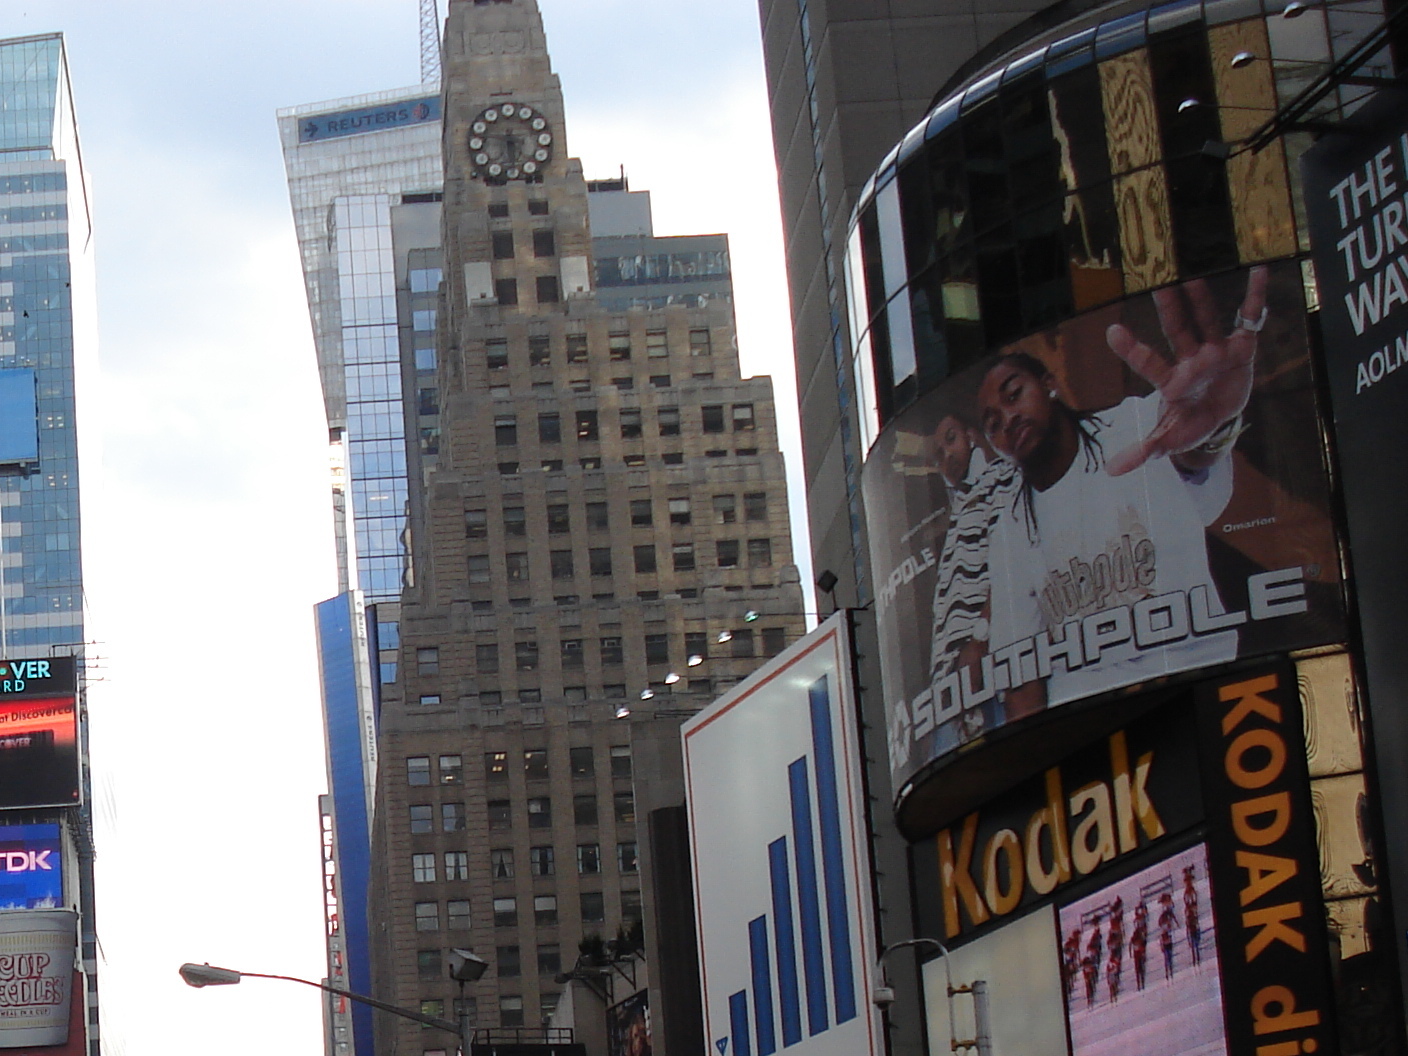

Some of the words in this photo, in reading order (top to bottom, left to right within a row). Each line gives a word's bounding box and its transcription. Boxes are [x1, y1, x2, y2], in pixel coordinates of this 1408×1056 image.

[327, 108, 409, 133] REUTERS
[1329, 146, 1397, 230] THE
[1222, 515, 1277, 534] Omarion
[912, 566, 1308, 742] SOUTHPOLE
[937, 729, 1167, 939] Kodak
[1219, 672, 1306, 964] KODAK
